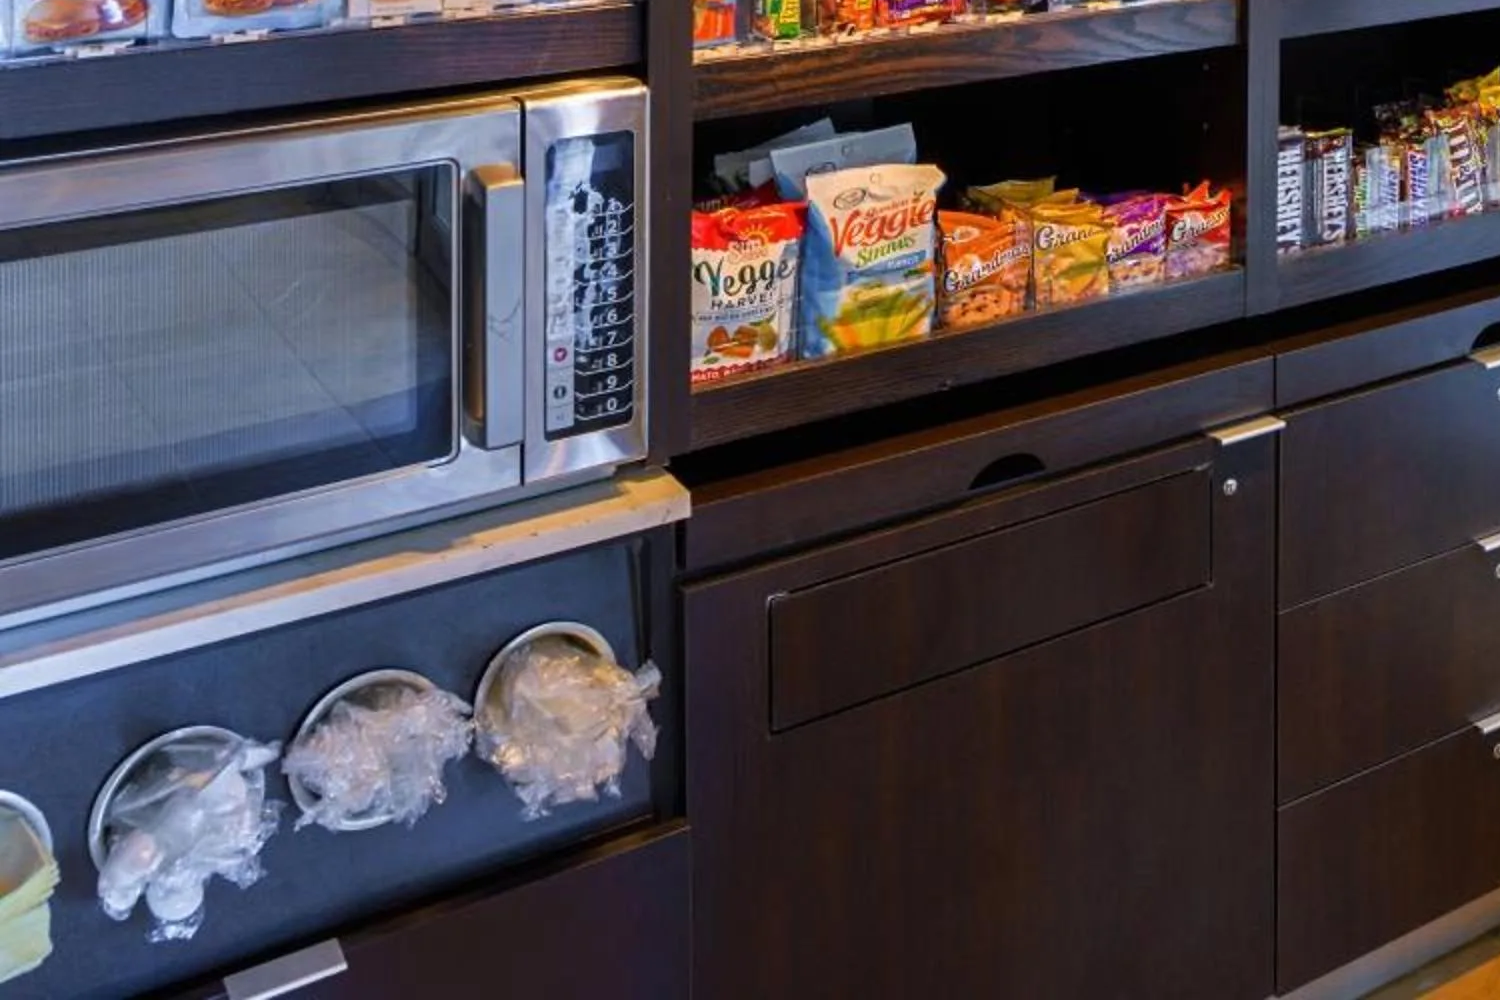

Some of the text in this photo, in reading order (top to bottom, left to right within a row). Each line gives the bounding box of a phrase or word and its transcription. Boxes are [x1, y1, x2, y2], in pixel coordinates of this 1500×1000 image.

[1322, 146, 1348, 243] HERSHEY'S
[829, 196, 936, 259] Veggie
[606, 309, 618, 323] 6
[606, 332, 618, 346] 7
[606, 353, 618, 367] 8
[606, 374, 618, 389] 9
[606, 397, 618, 411] 0
